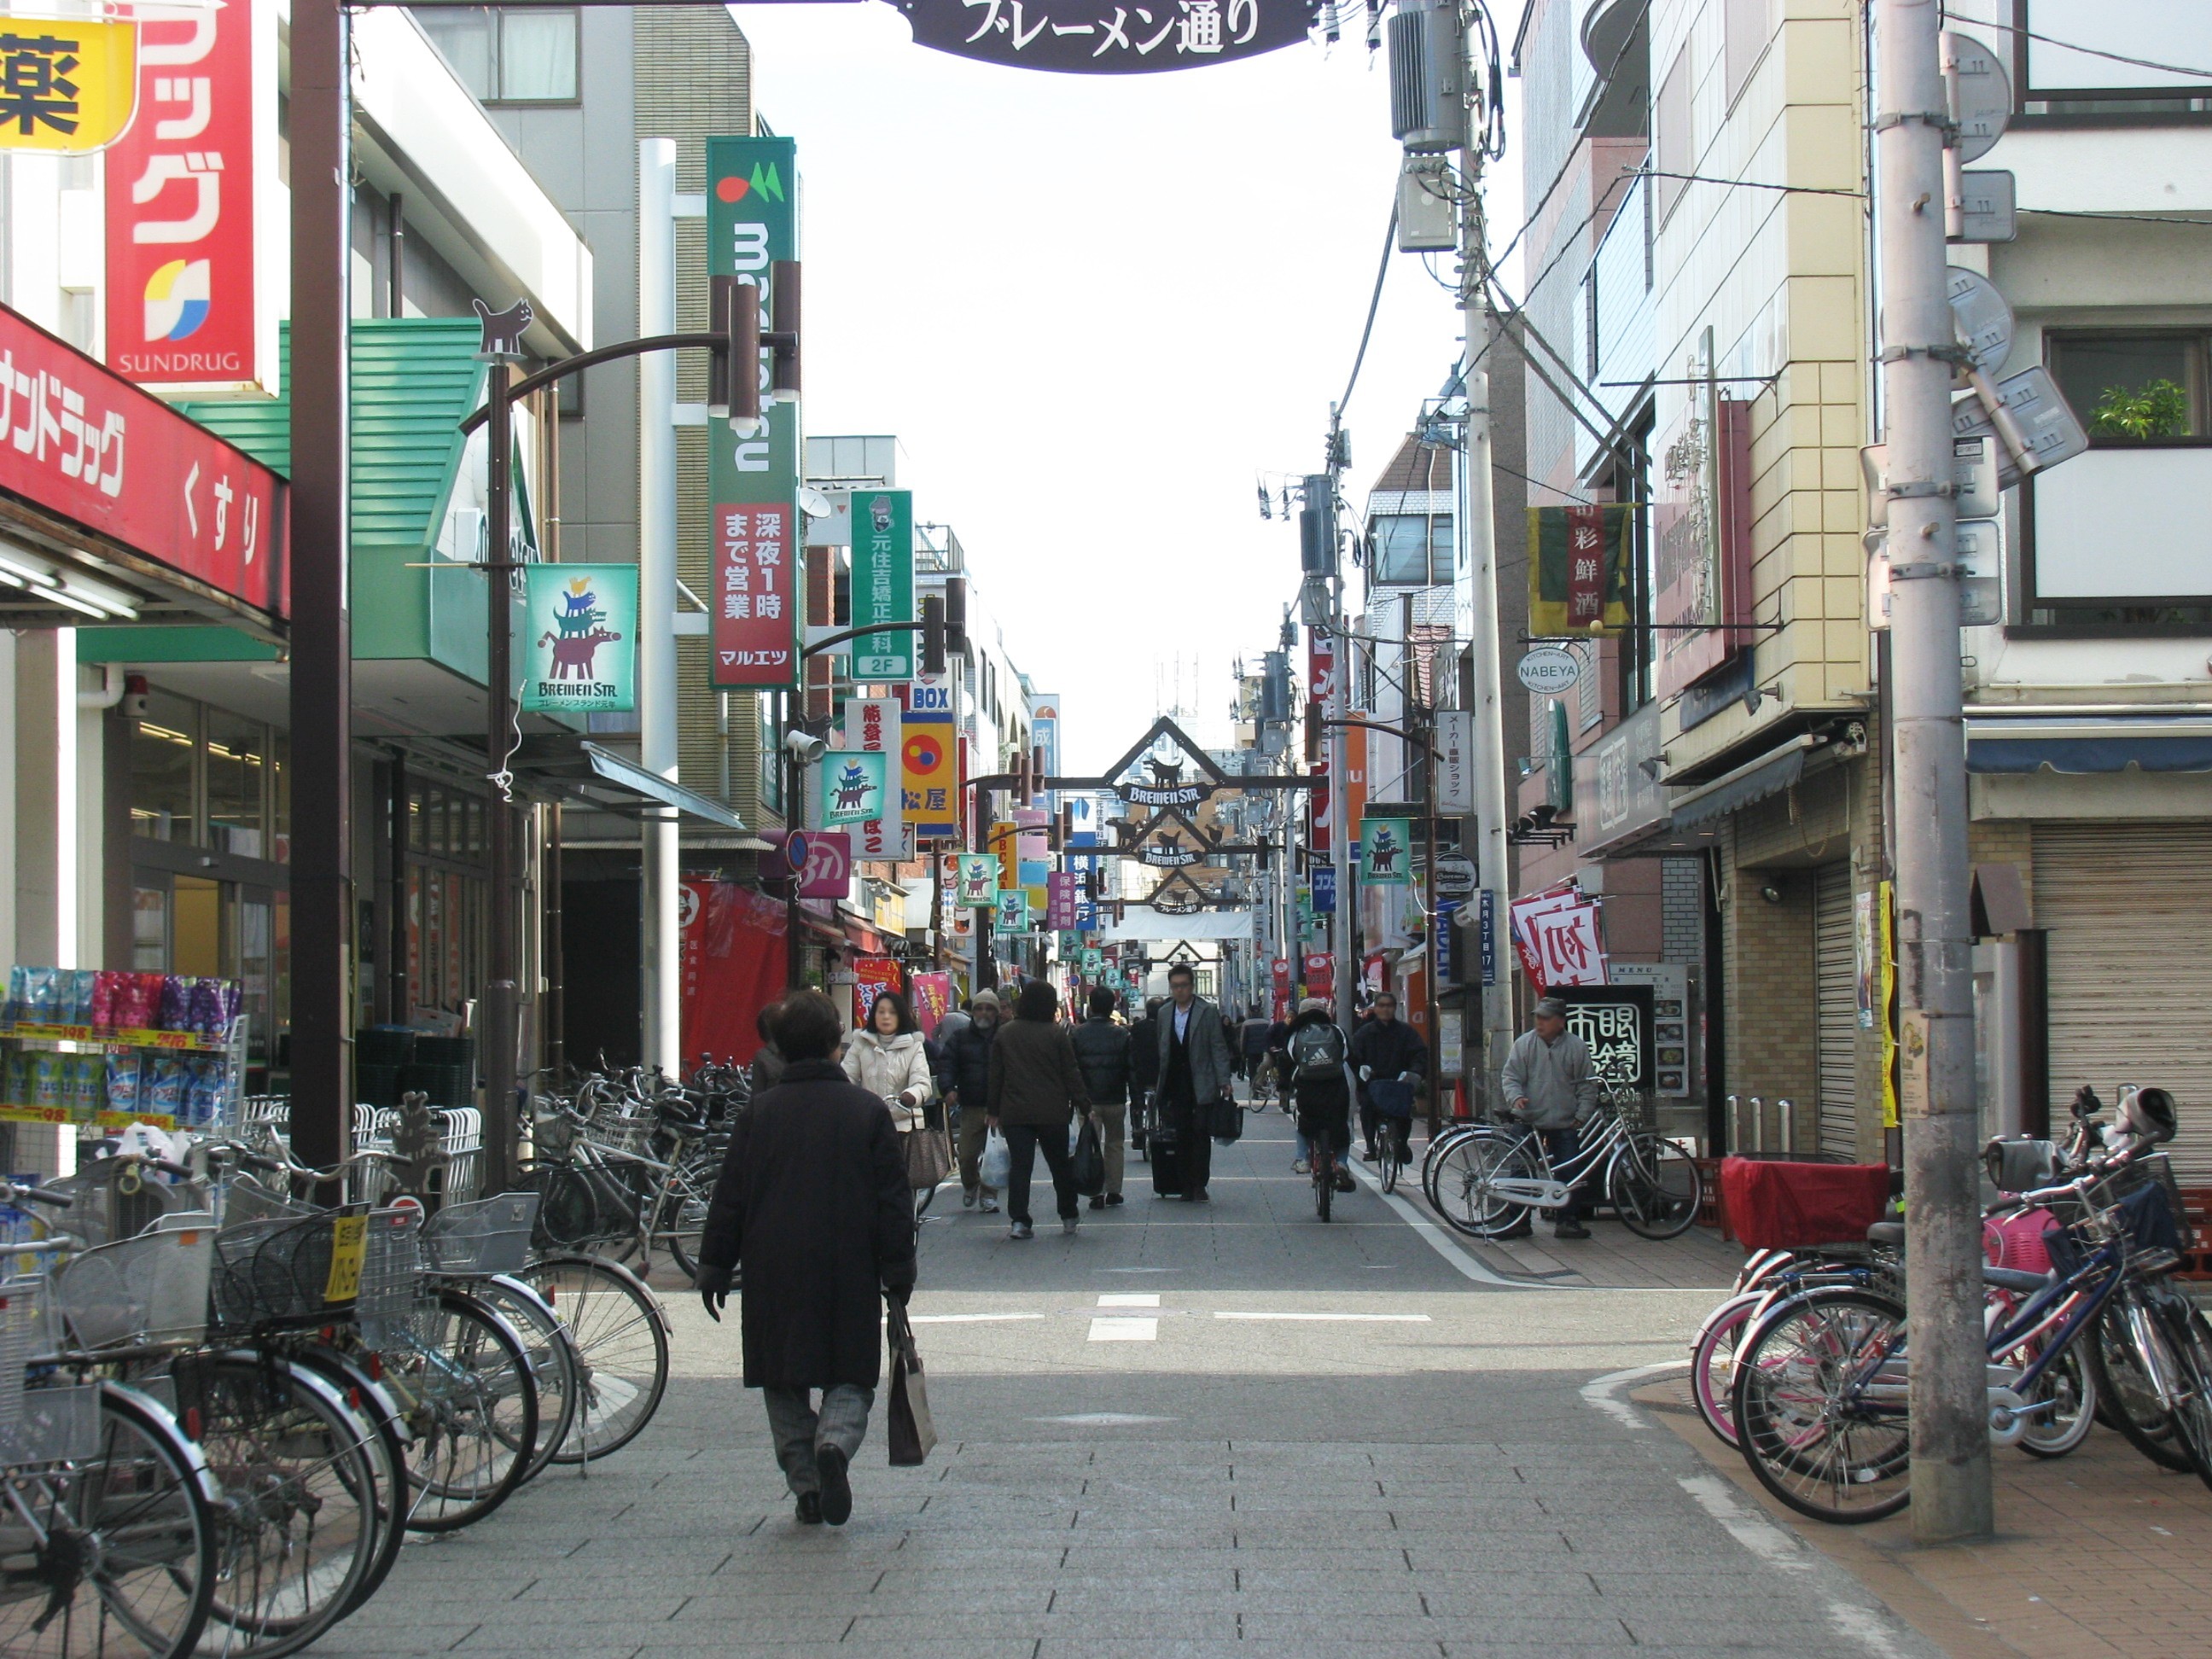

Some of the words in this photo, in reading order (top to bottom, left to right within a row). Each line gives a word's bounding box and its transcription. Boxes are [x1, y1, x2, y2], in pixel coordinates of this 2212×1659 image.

[962, 0, 1259, 57] ブレーメン通り
[0, 34, 79, 137] 薬
[119, 352, 240, 373] SUNDRUG
[184, 459, 258, 565] くすり
[725, 514, 750, 620] まで営業
[755, 513, 781, 620] 深夜1時
[719, 650, 787, 666] マルエツ
[871, 659, 893, 672] 2F
[1520, 667, 1575, 677] NABEYA
[914, 688, 948, 709] BOX
[902, 789, 946, 810] 松屋
[800, 854, 835, 888] 31
[1074, 855, 1090, 922] 横浜銀行
[62, 1026, 87, 1039] 198
[1598, 1005, 1637, 1083] 眼鏡
